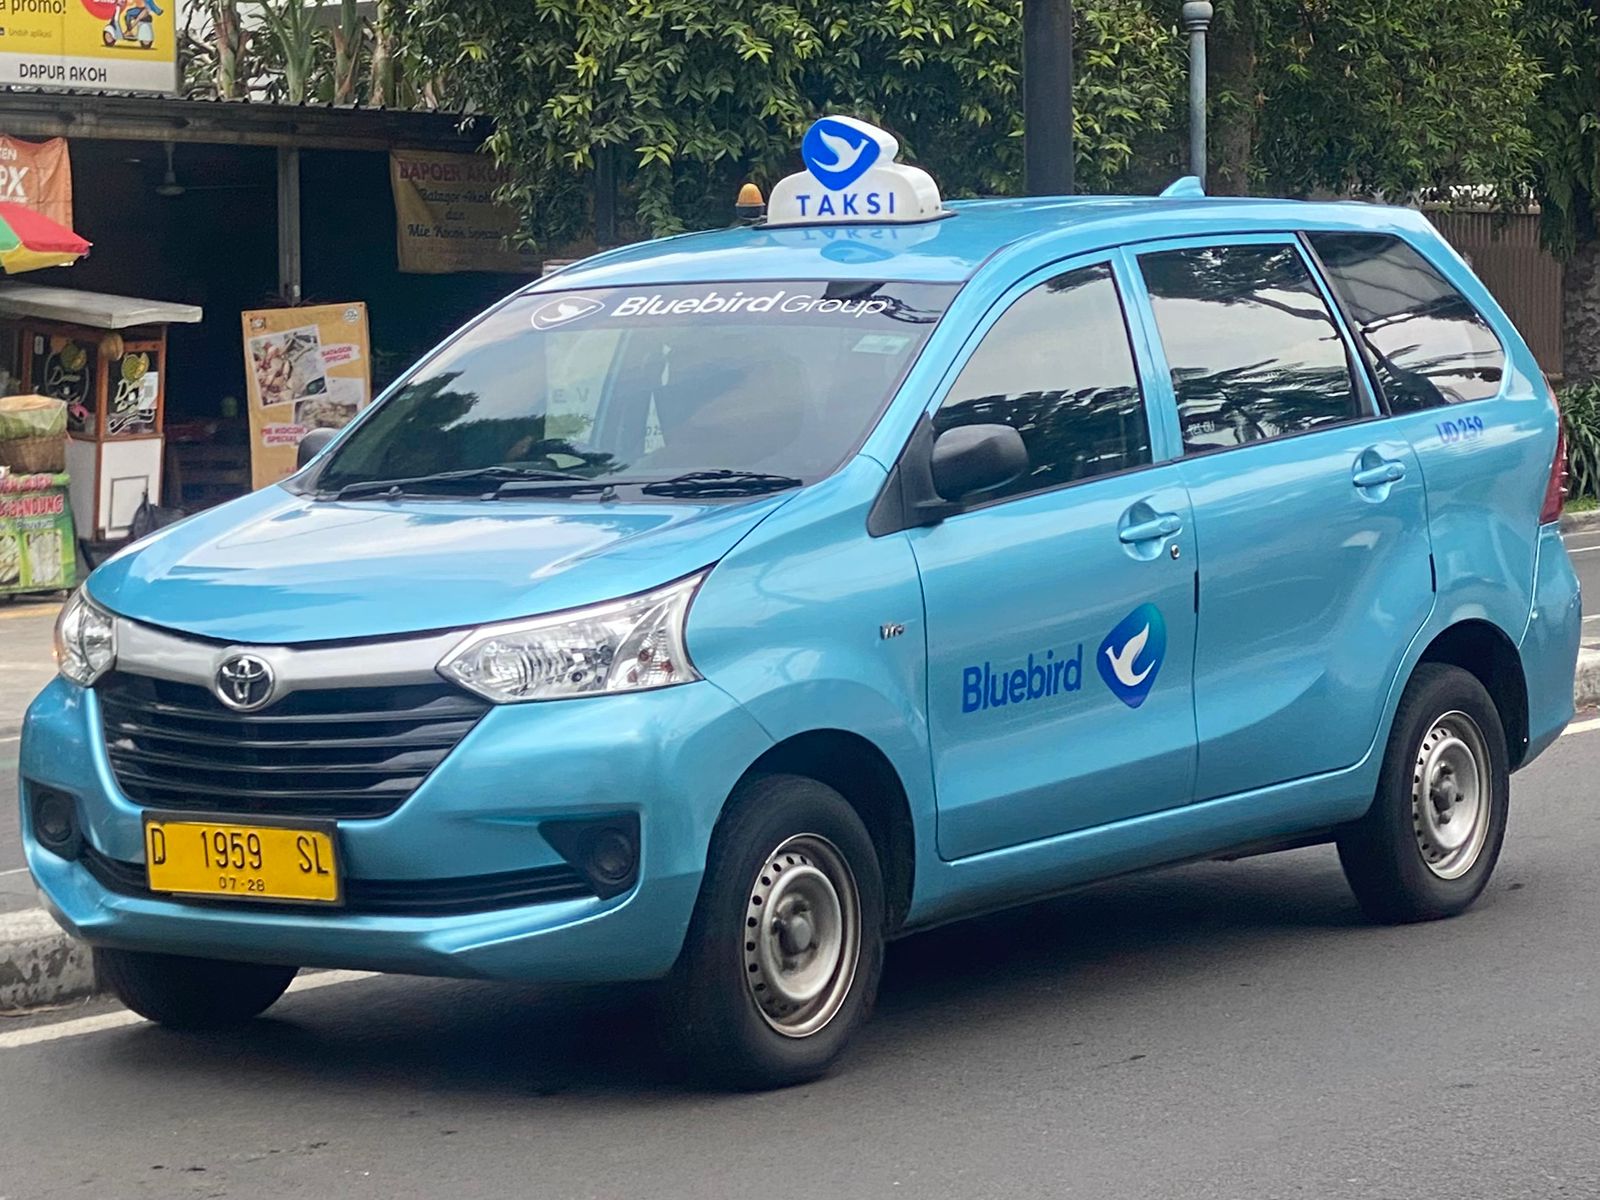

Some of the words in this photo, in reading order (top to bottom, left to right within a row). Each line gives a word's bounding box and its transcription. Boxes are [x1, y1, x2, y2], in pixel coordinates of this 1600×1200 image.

[11, 0, 67, 15] promo!
[19, 63, 66, 80] DAPUR
[69, 66, 107, 82] AKOH
[796, 192, 894, 217] TAKSI
[611, 290, 786, 317] Bluebird
[780, 294, 887, 318] Group
[1436, 421, 1459, 444] UD
[1457, 415, 1483, 440] 259
[962, 644, 1083, 713] Bluebird
[151, 828, 166, 865] D
[201, 831, 263, 870] 1959
[296, 835, 330, 875] SL
